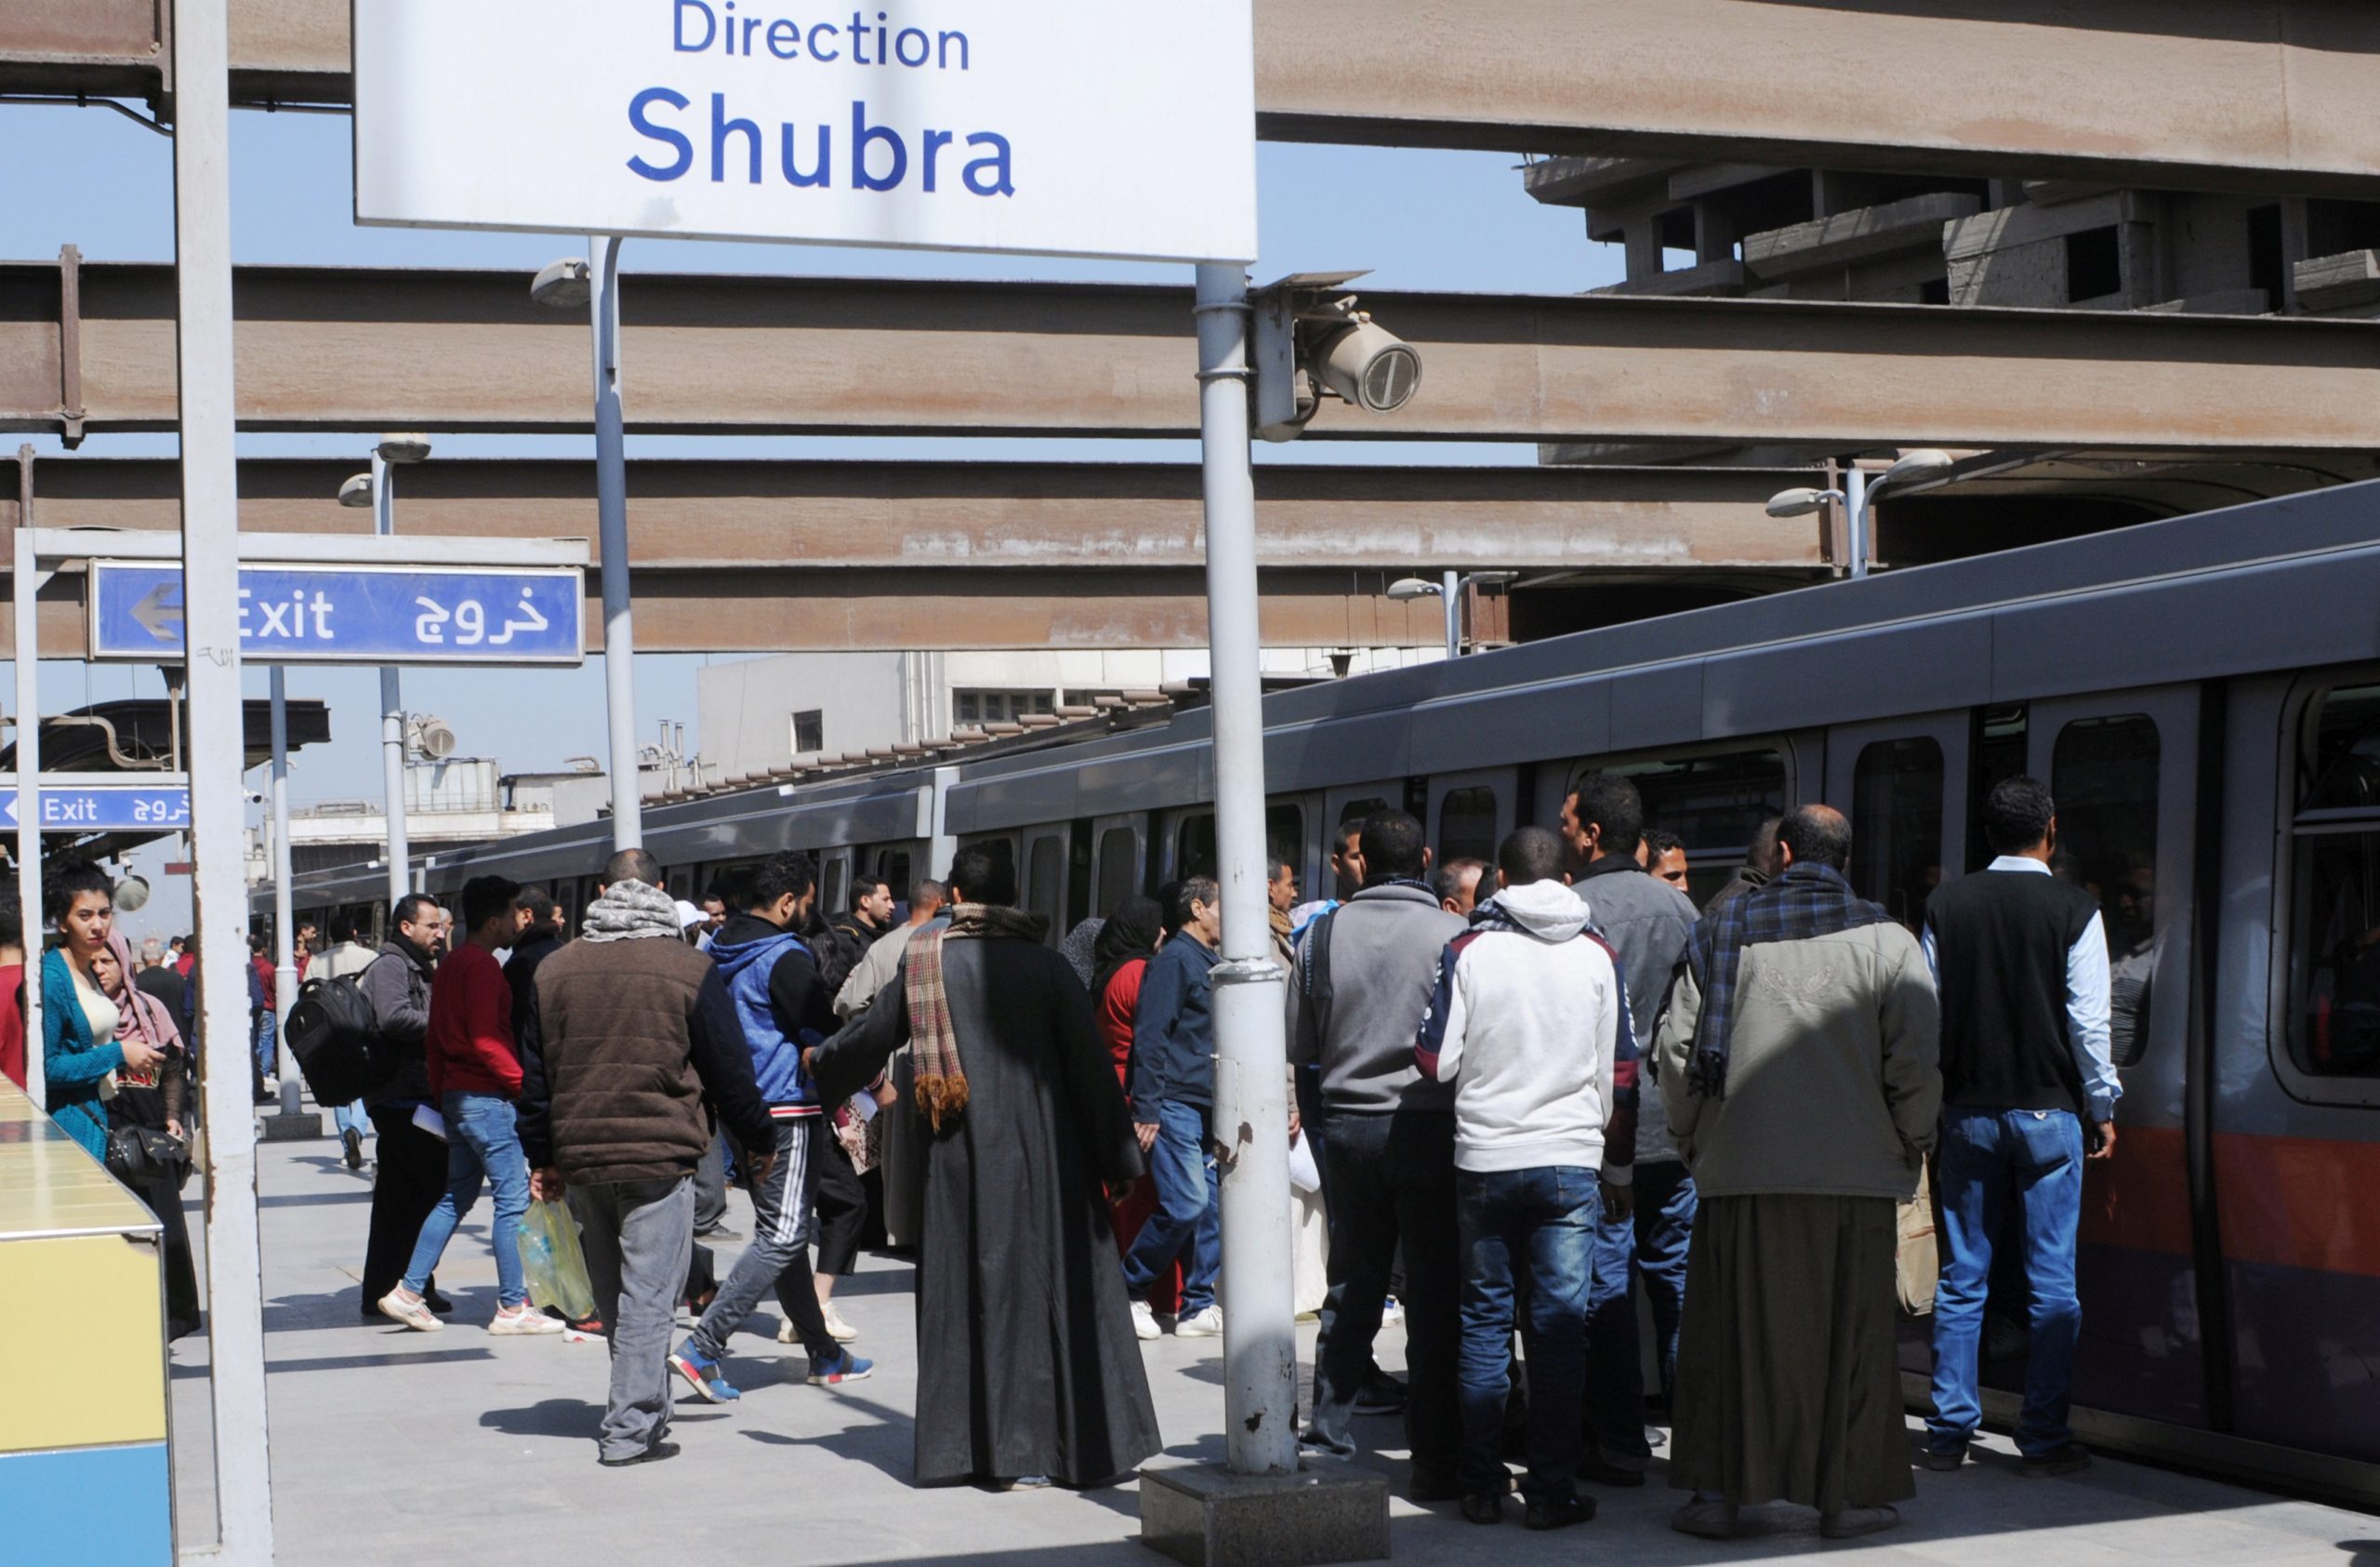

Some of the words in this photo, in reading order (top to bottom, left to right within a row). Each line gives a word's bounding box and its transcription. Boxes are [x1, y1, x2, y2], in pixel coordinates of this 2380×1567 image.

[673, 0, 969, 70] Direction
[626, 86, 1016, 198] Shubra
[415, 587, 549, 645] خروج
[45, 798, 98, 821] Exit
